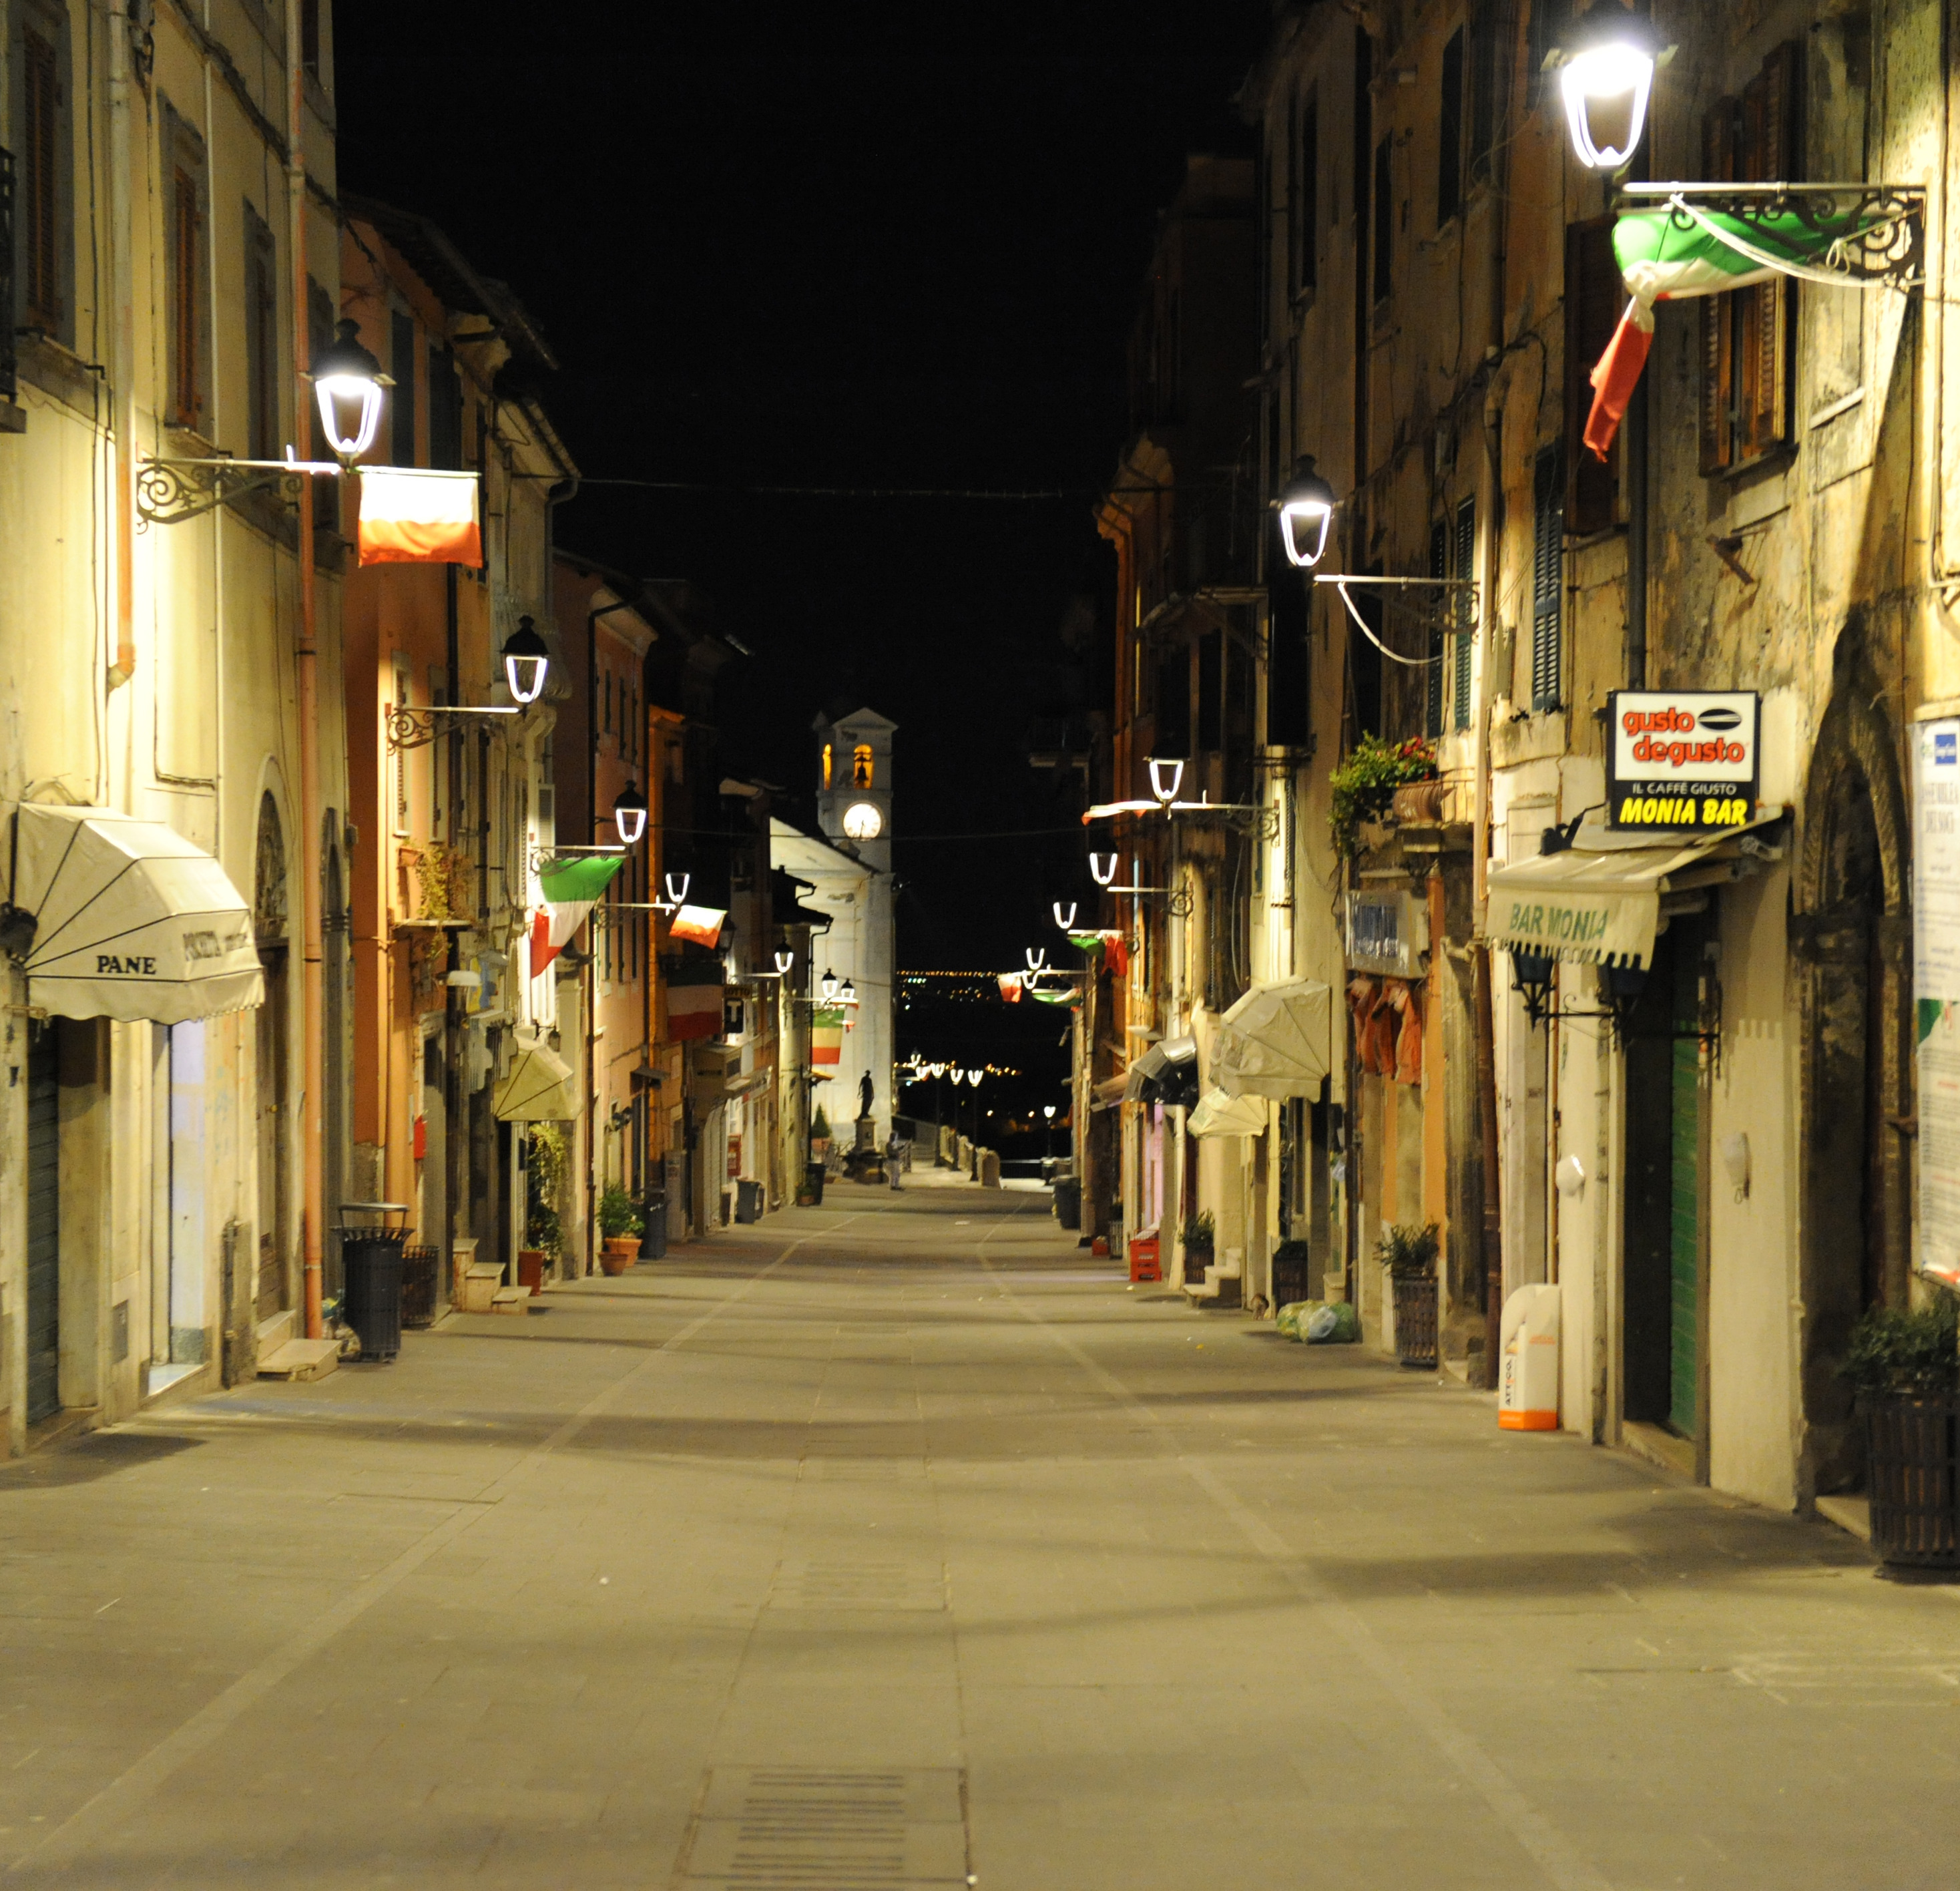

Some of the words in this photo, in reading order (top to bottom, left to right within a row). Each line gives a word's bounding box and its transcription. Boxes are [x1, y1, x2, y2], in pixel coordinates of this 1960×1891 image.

[1622, 706, 1696, 737] gusto
[1633, 735, 1745, 767] degusto
[1632, 783, 1644, 794] IL
[1690, 783, 1737, 795] GIUSTO
[1619, 797, 1696, 825] MONIA
[1702, 799, 1748, 826] BAR
[1509, 903, 1544, 935] BAR
[1547, 906, 1609, 941] MONIA
[96, 955, 156, 975] PANE
[727, 1001, 742, 1022] T
